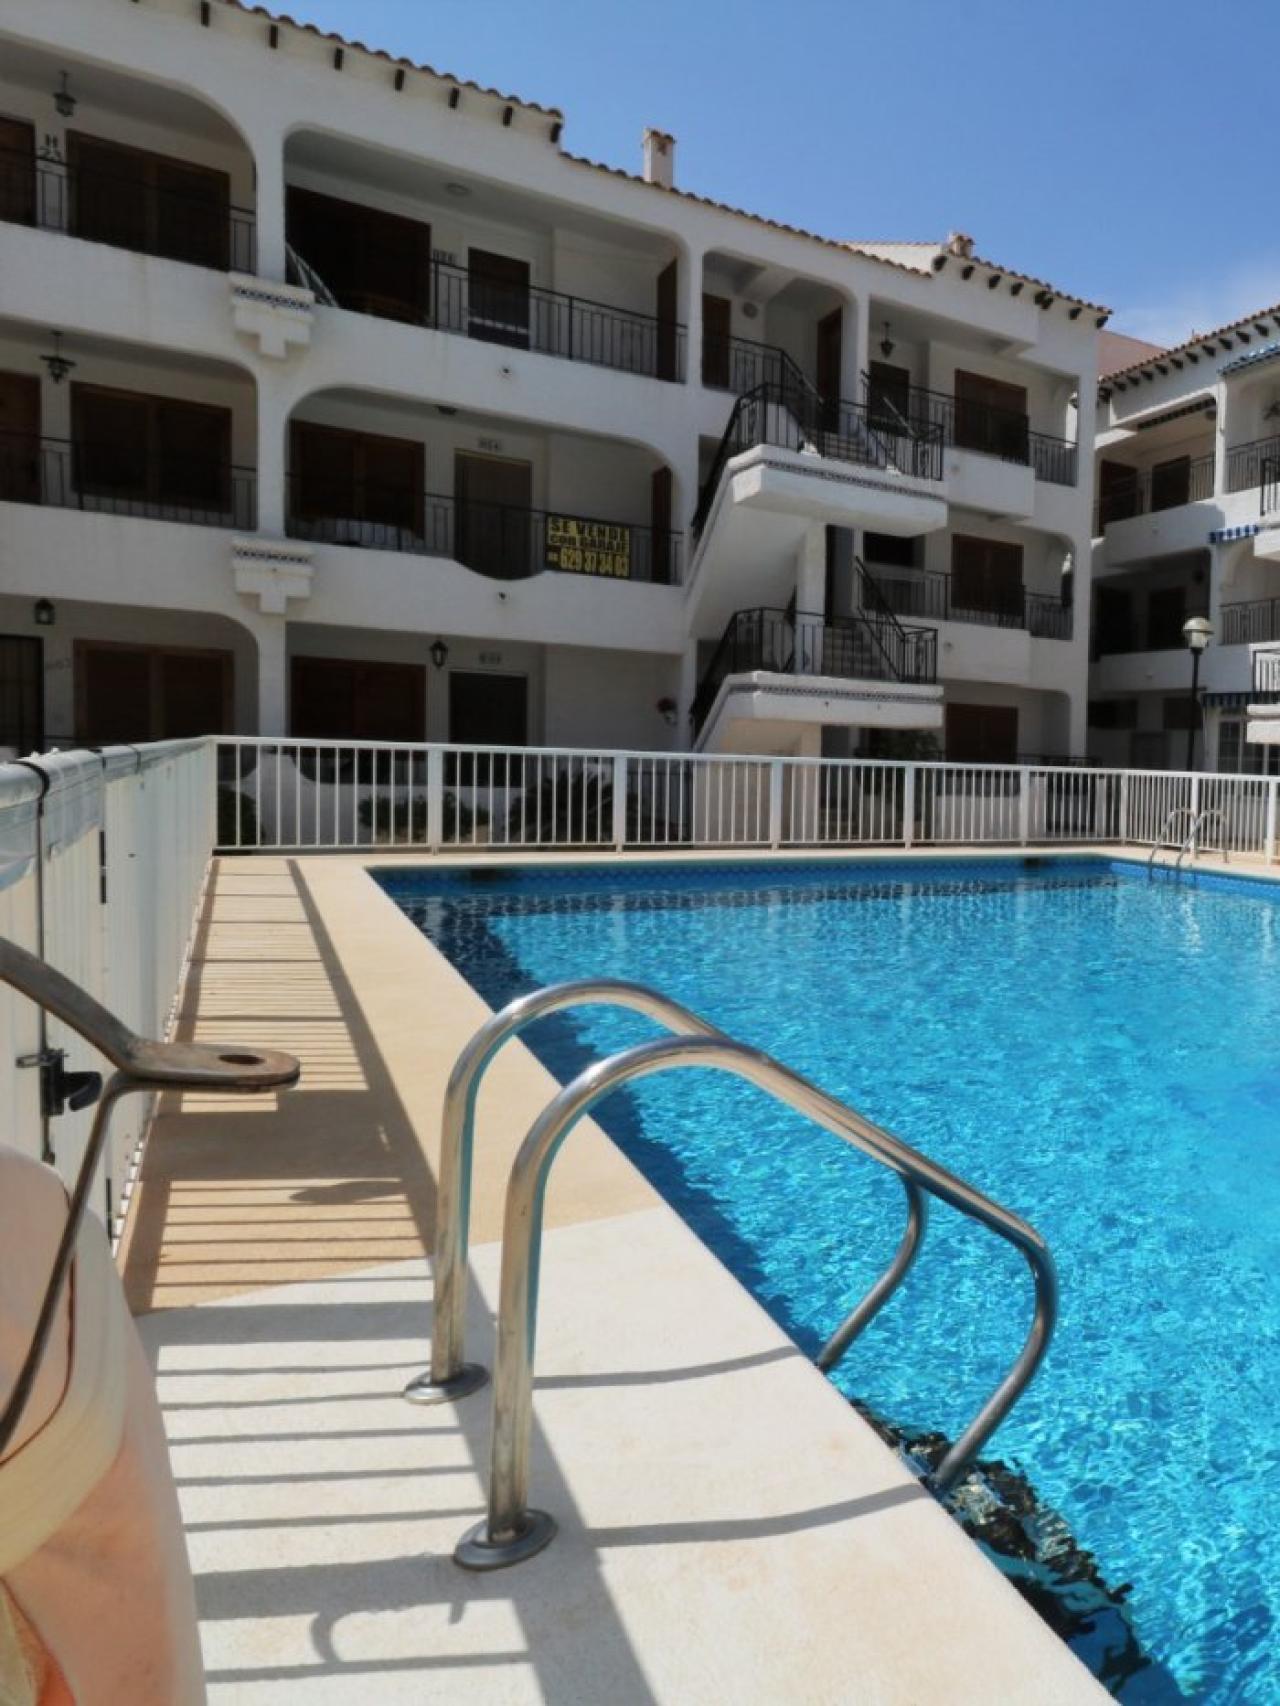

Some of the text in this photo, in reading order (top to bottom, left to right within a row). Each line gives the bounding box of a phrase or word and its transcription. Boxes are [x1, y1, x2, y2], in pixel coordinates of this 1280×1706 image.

[549, 517, 629, 540] SE VENDE
[560, 547, 583, 571] 629
